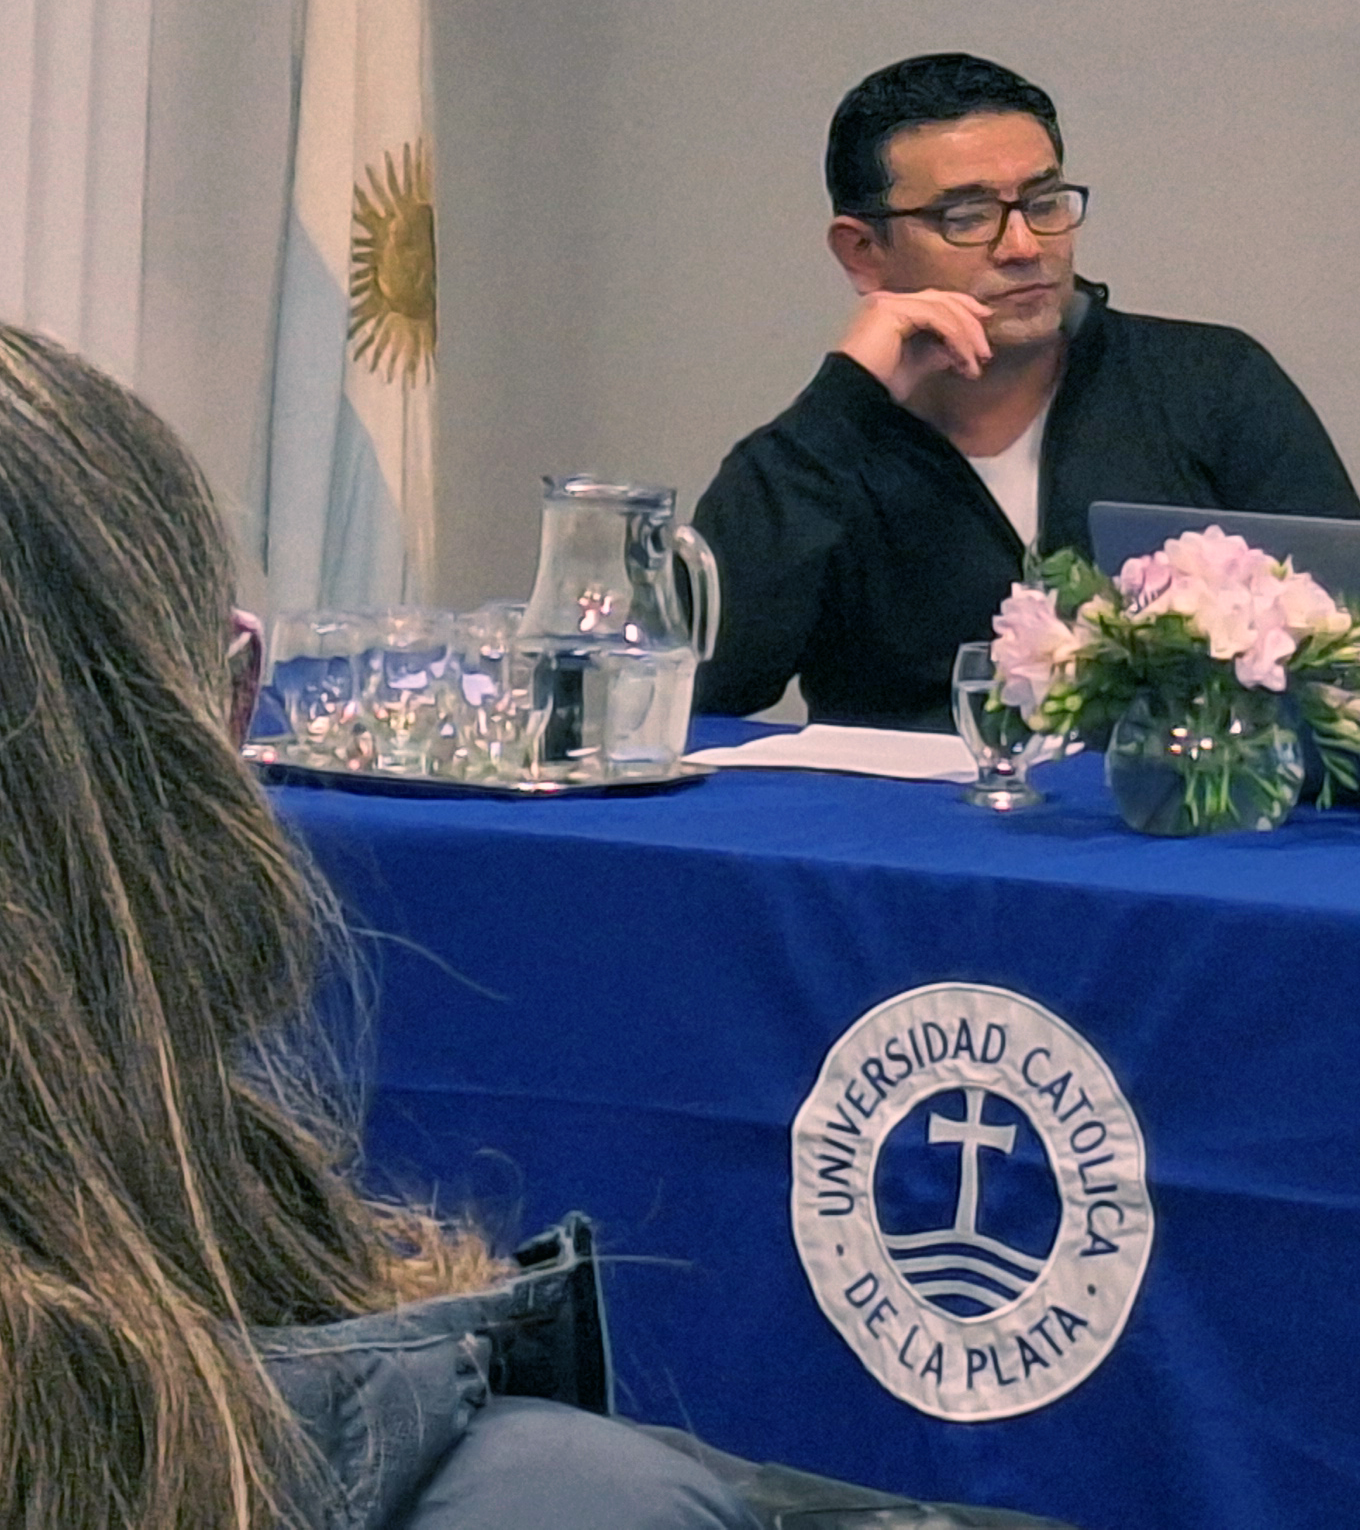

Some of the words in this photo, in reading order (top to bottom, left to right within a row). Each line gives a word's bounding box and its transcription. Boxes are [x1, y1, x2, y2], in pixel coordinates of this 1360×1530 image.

[818, 1018, 1007, 1217] UNIVERSIDAD
[844, 1272, 899, 1339] DE
[898, 1324, 944, 1386] LA
[966, 1305, 1090, 1390] PLATA
